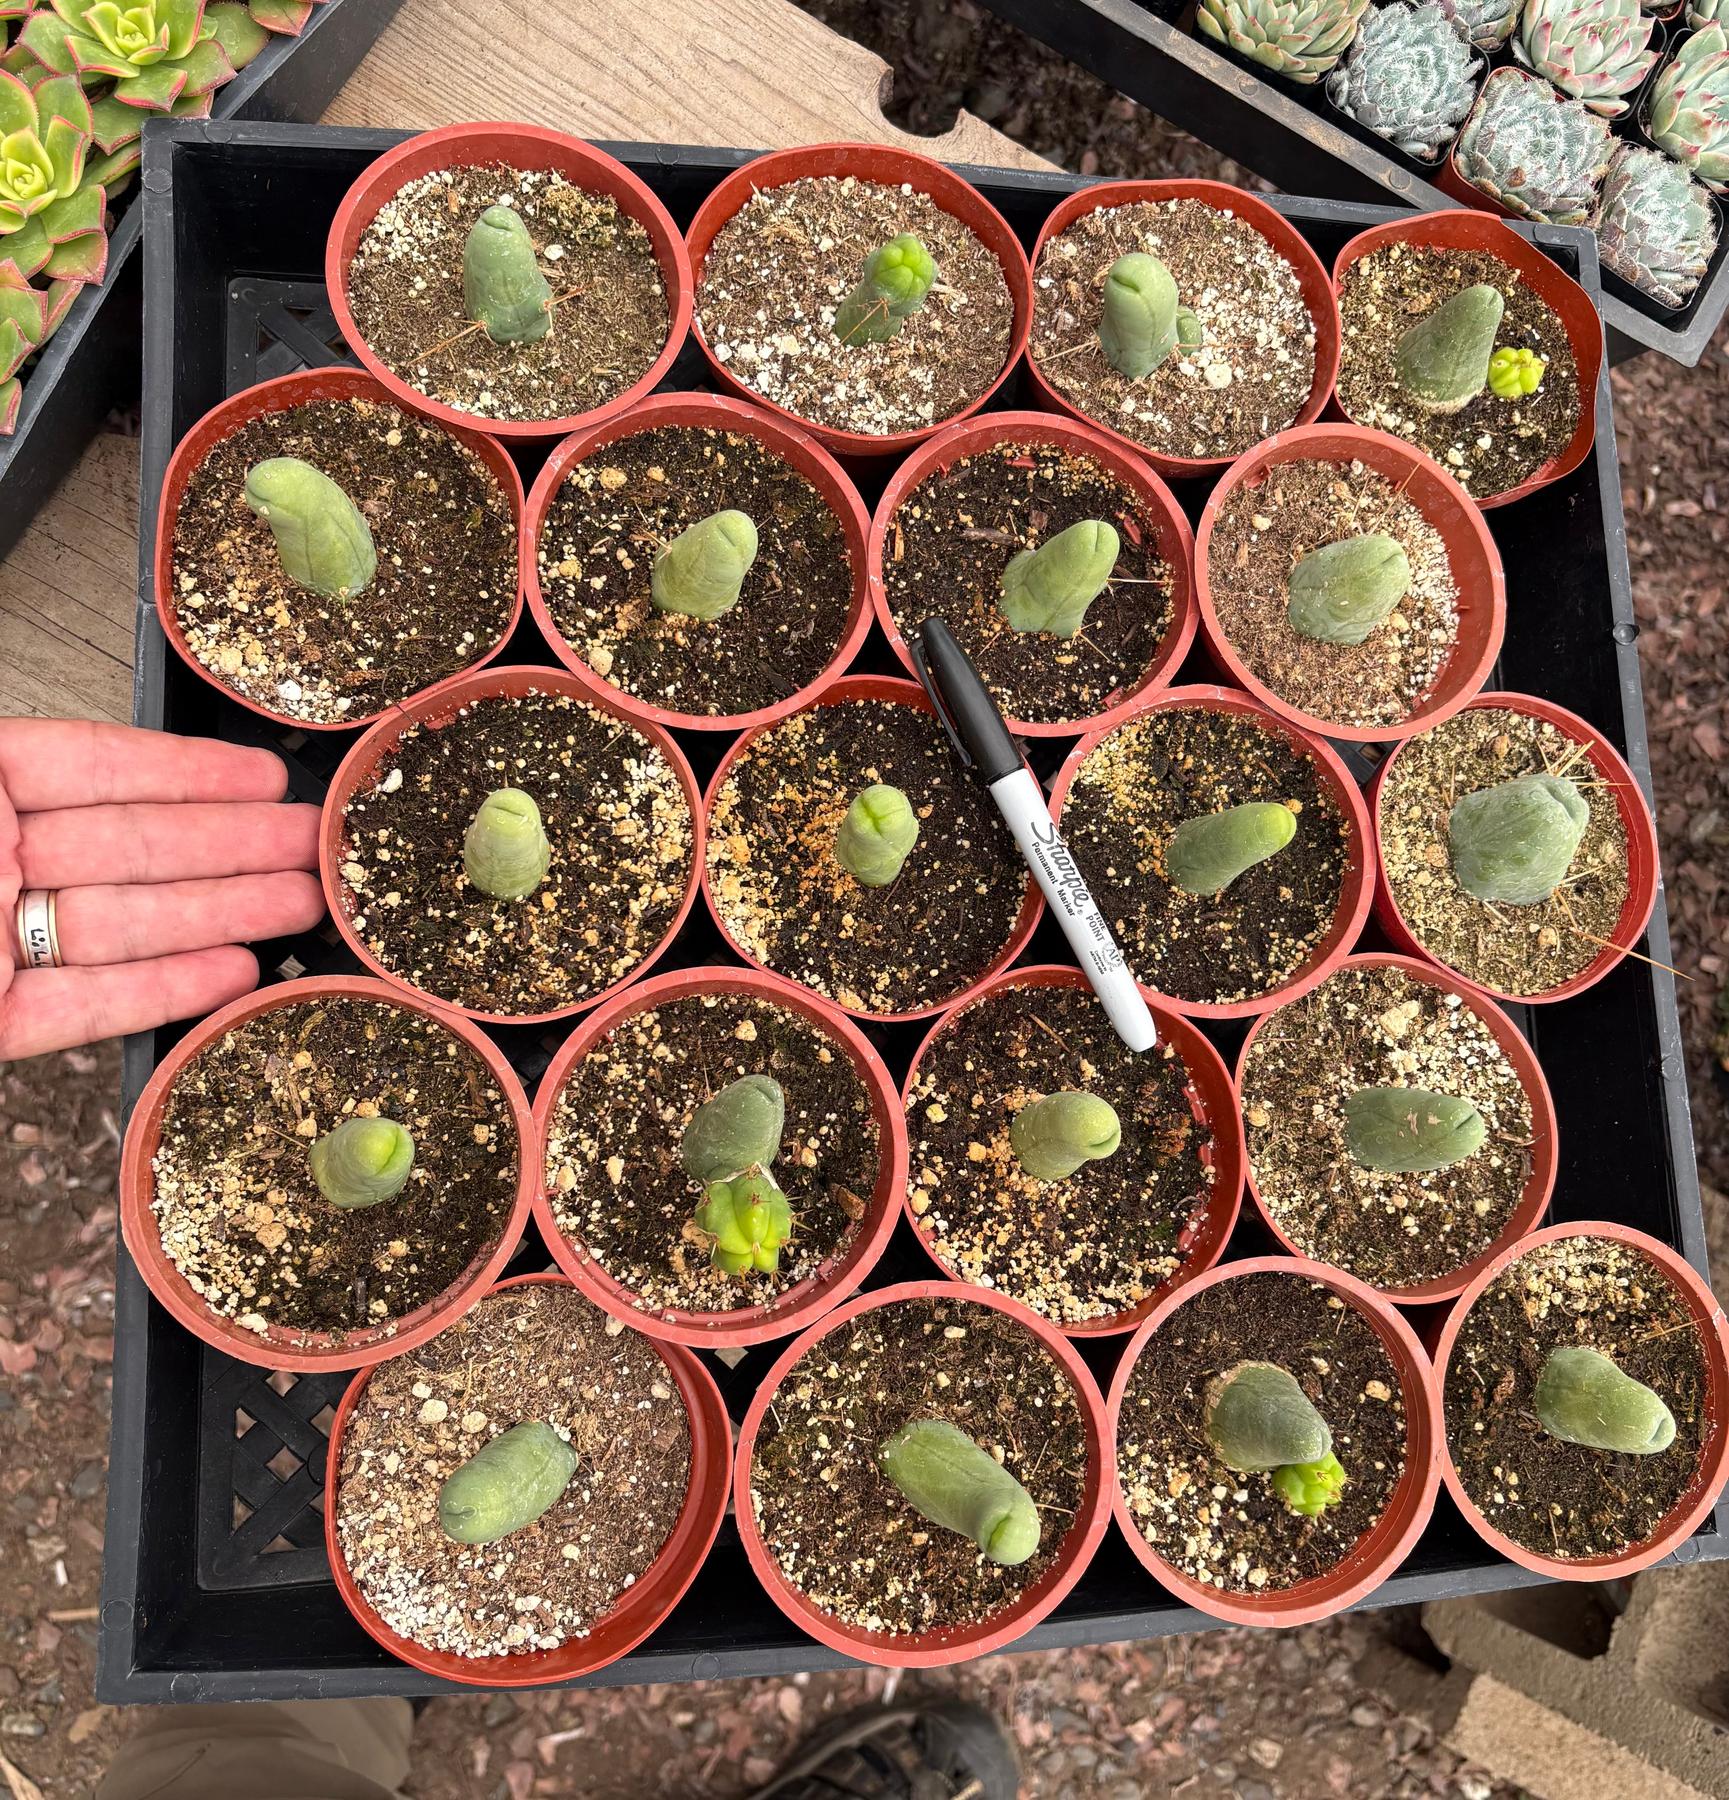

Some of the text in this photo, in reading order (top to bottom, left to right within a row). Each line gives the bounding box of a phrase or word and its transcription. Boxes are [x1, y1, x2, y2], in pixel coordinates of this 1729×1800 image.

[1030, 821, 1090, 907] Sharpie
[1031, 841, 1075, 916] Permanent Marker
[1086, 915, 1105, 941] POINT
[1094, 912, 1106, 931] FINE
